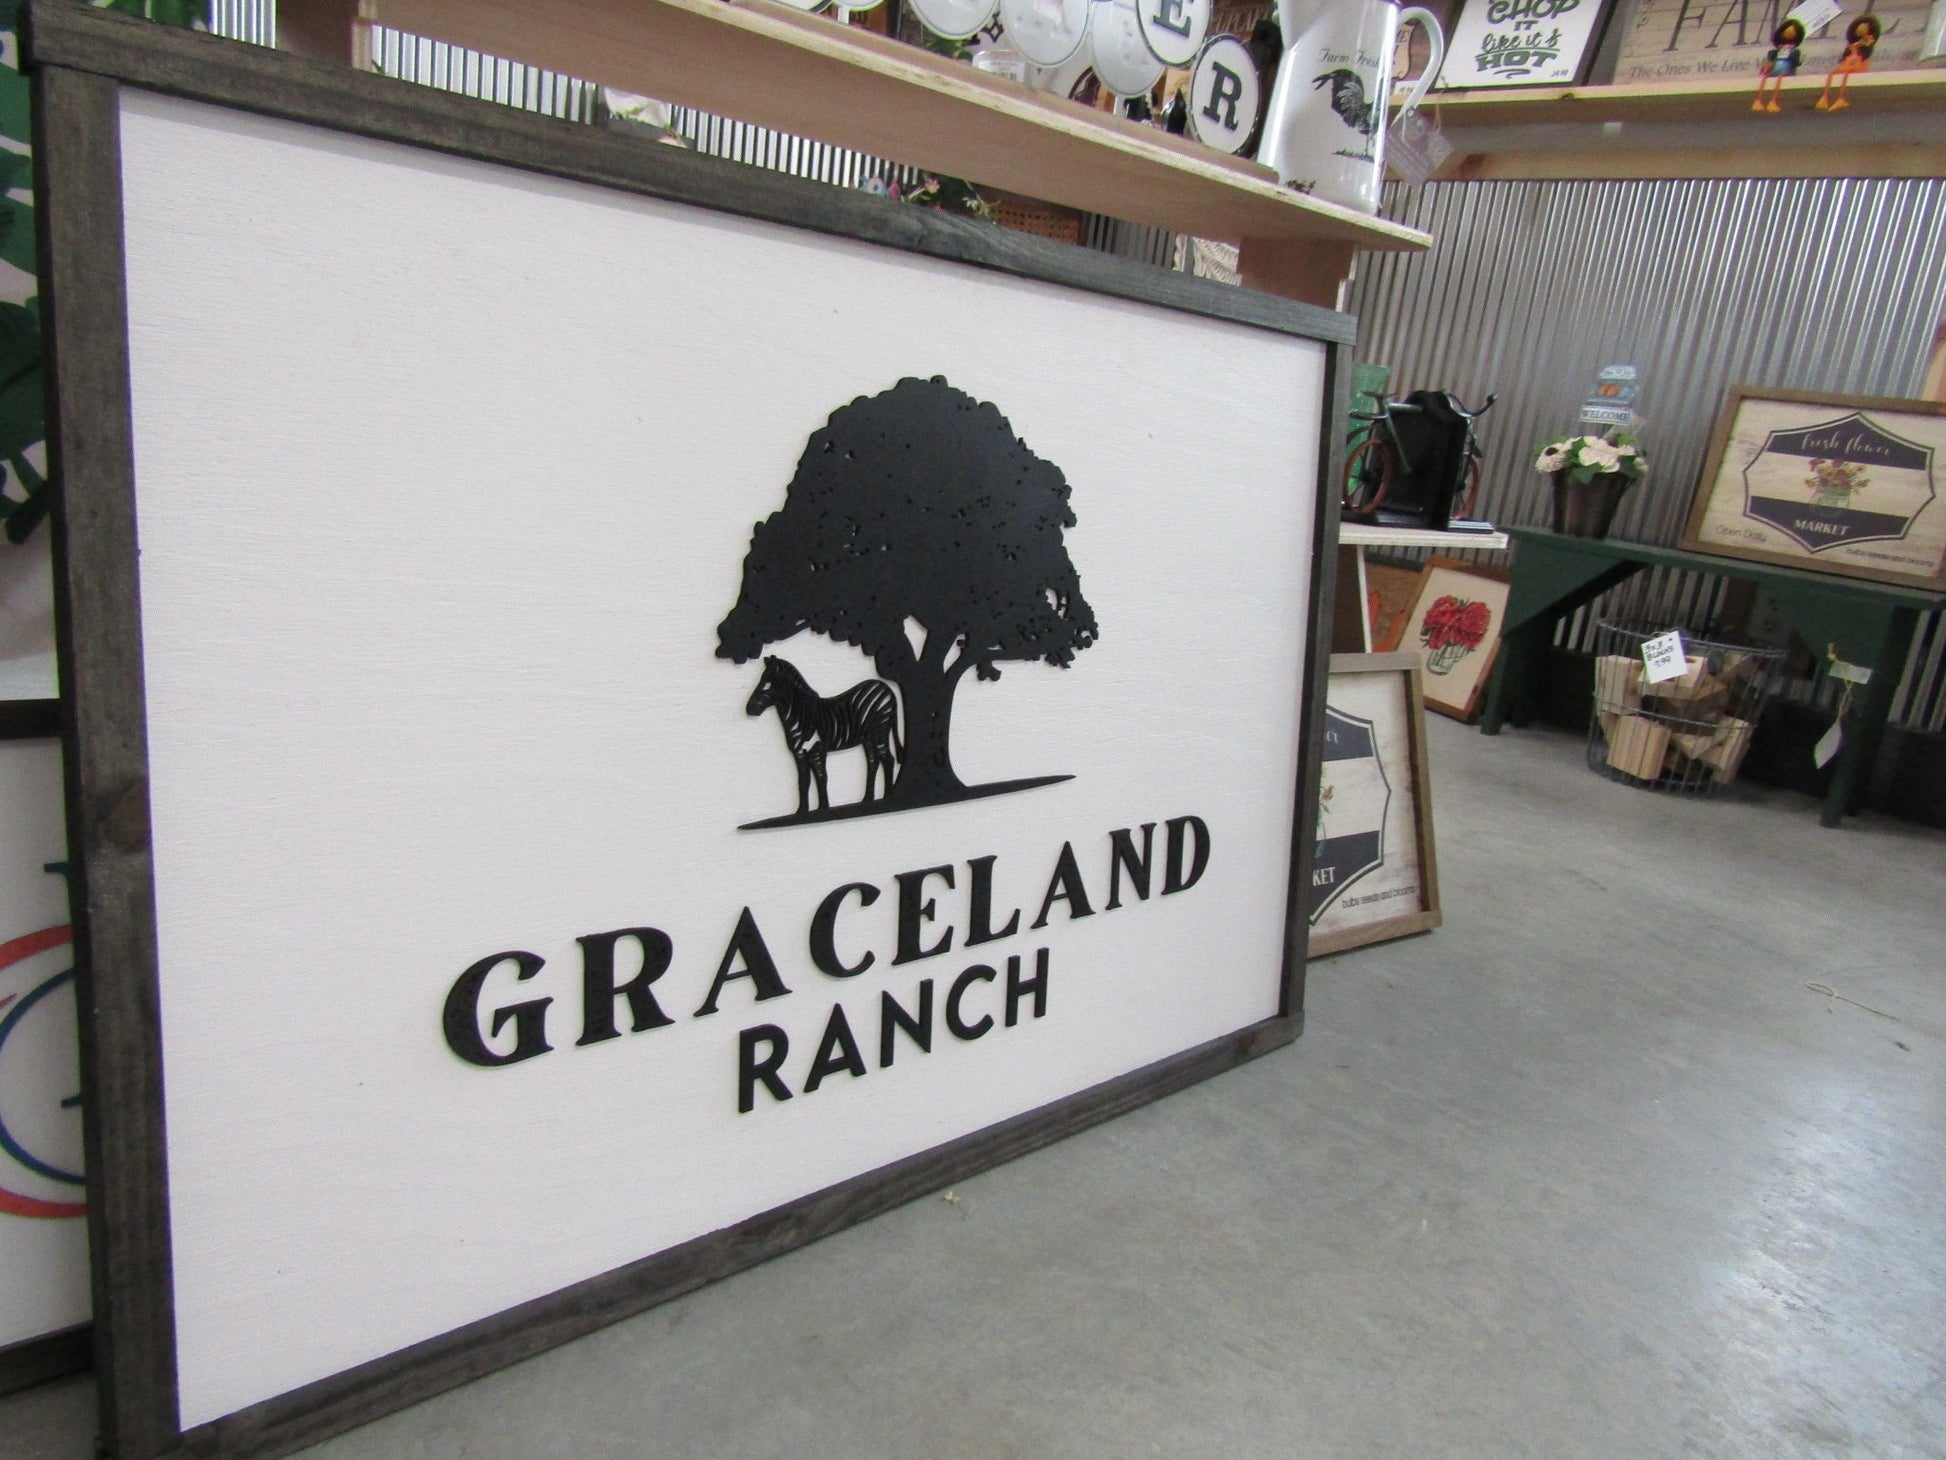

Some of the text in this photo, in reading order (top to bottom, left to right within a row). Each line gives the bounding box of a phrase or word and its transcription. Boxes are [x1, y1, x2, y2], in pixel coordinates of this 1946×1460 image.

[1513, 19, 1540, 31] IT
[1481, 33, 1521, 53] like
[1318, 48, 1350, 63] Farm
[1475, 51, 1558, 72] HOT
[1697, 61, 1718, 74] We
[1721, 59, 1750, 72] Live
[1203, 61, 1242, 131] R
[1581, 410, 1630, 421] WELCOME
[1794, 519, 1850, 537] MARKET
[1313, 867, 1336, 887] KET
[442, 814, 1211, 1067] GRACELAND
[738, 947, 1049, 1114] RANCH
